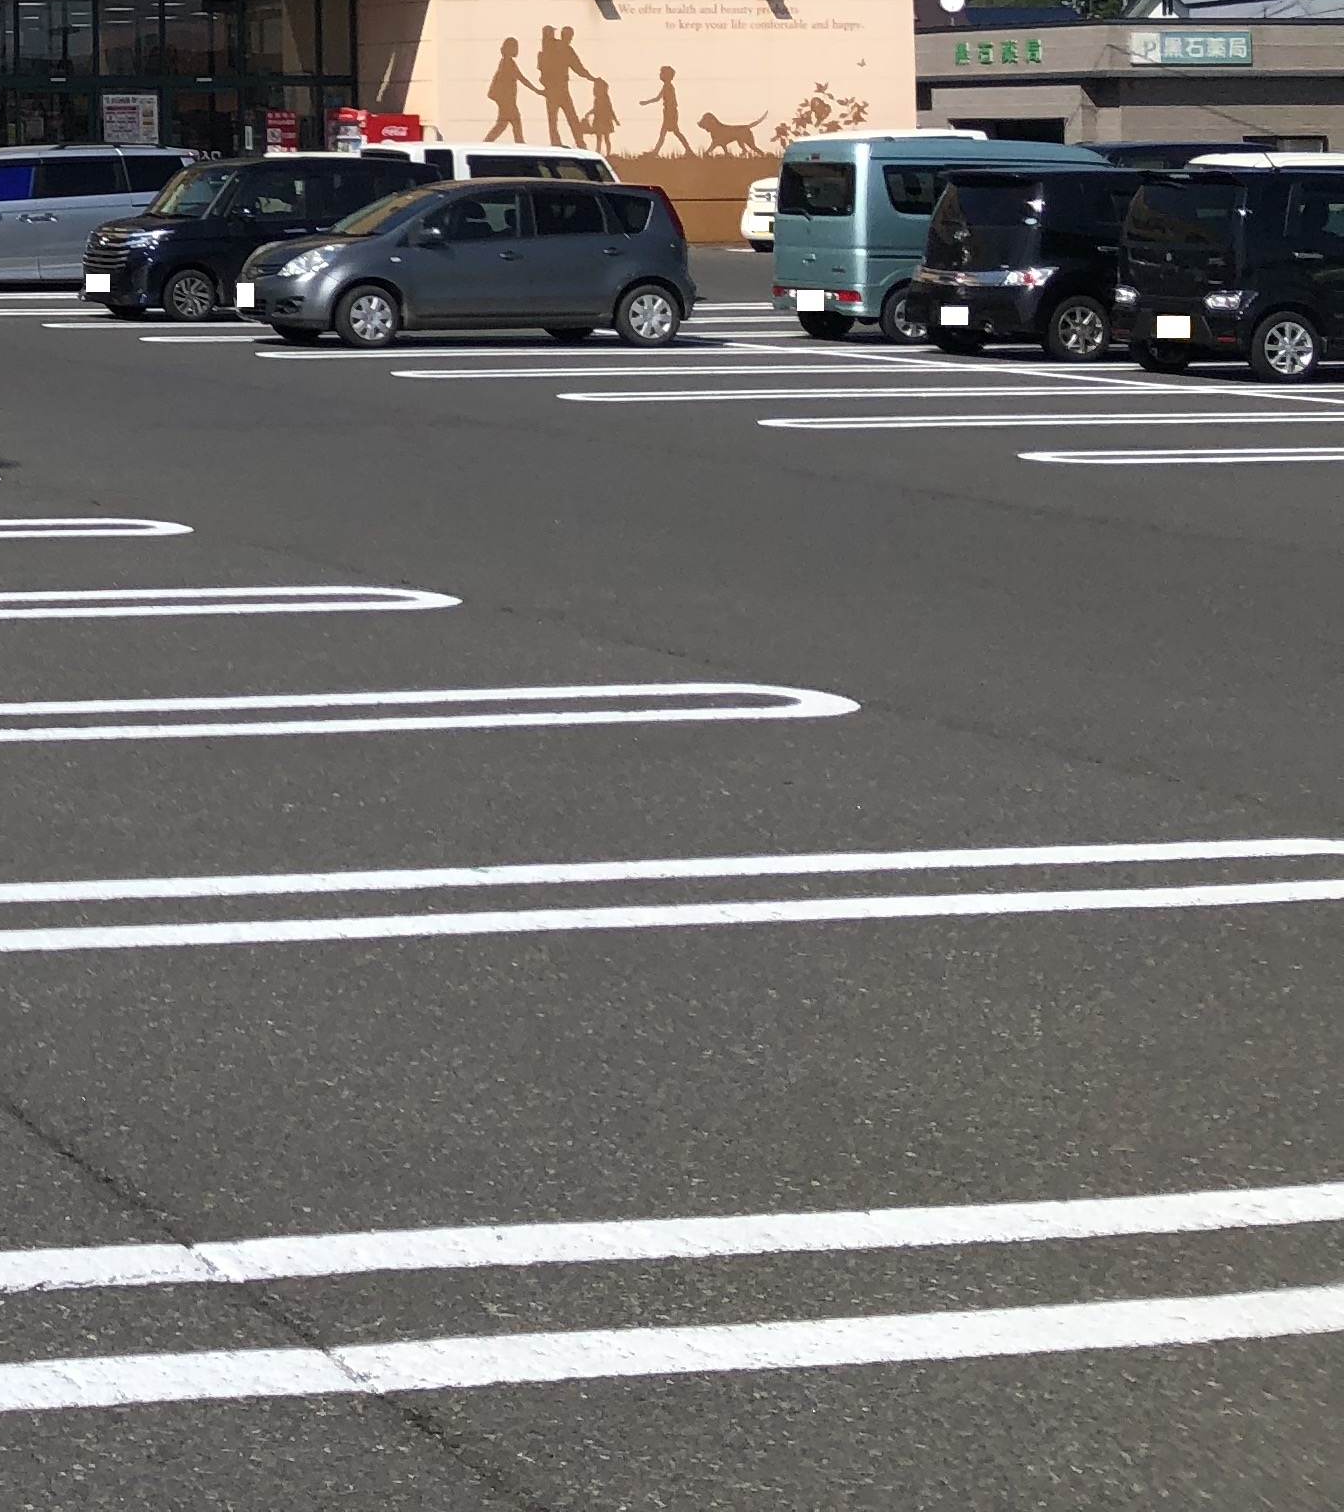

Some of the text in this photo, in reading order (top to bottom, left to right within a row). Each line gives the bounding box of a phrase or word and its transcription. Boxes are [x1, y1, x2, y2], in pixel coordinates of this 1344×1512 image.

[619, 4, 637, 15] We
[638, 3, 662, 15] offer
[665, 3, 696, 15] health
[699, 3, 717, 15] and
[720, 3, 753, 17] beauty
[665, 20, 676, 30] to
[678, 19, 702, 32] keep
[705, 21, 729, 32] your
[731, 19, 747, 30] life
[749, 19, 808, 30] comfortable
[811, 19, 829, 30] and
[1164, 37, 1247, 58] 黒石薬局
